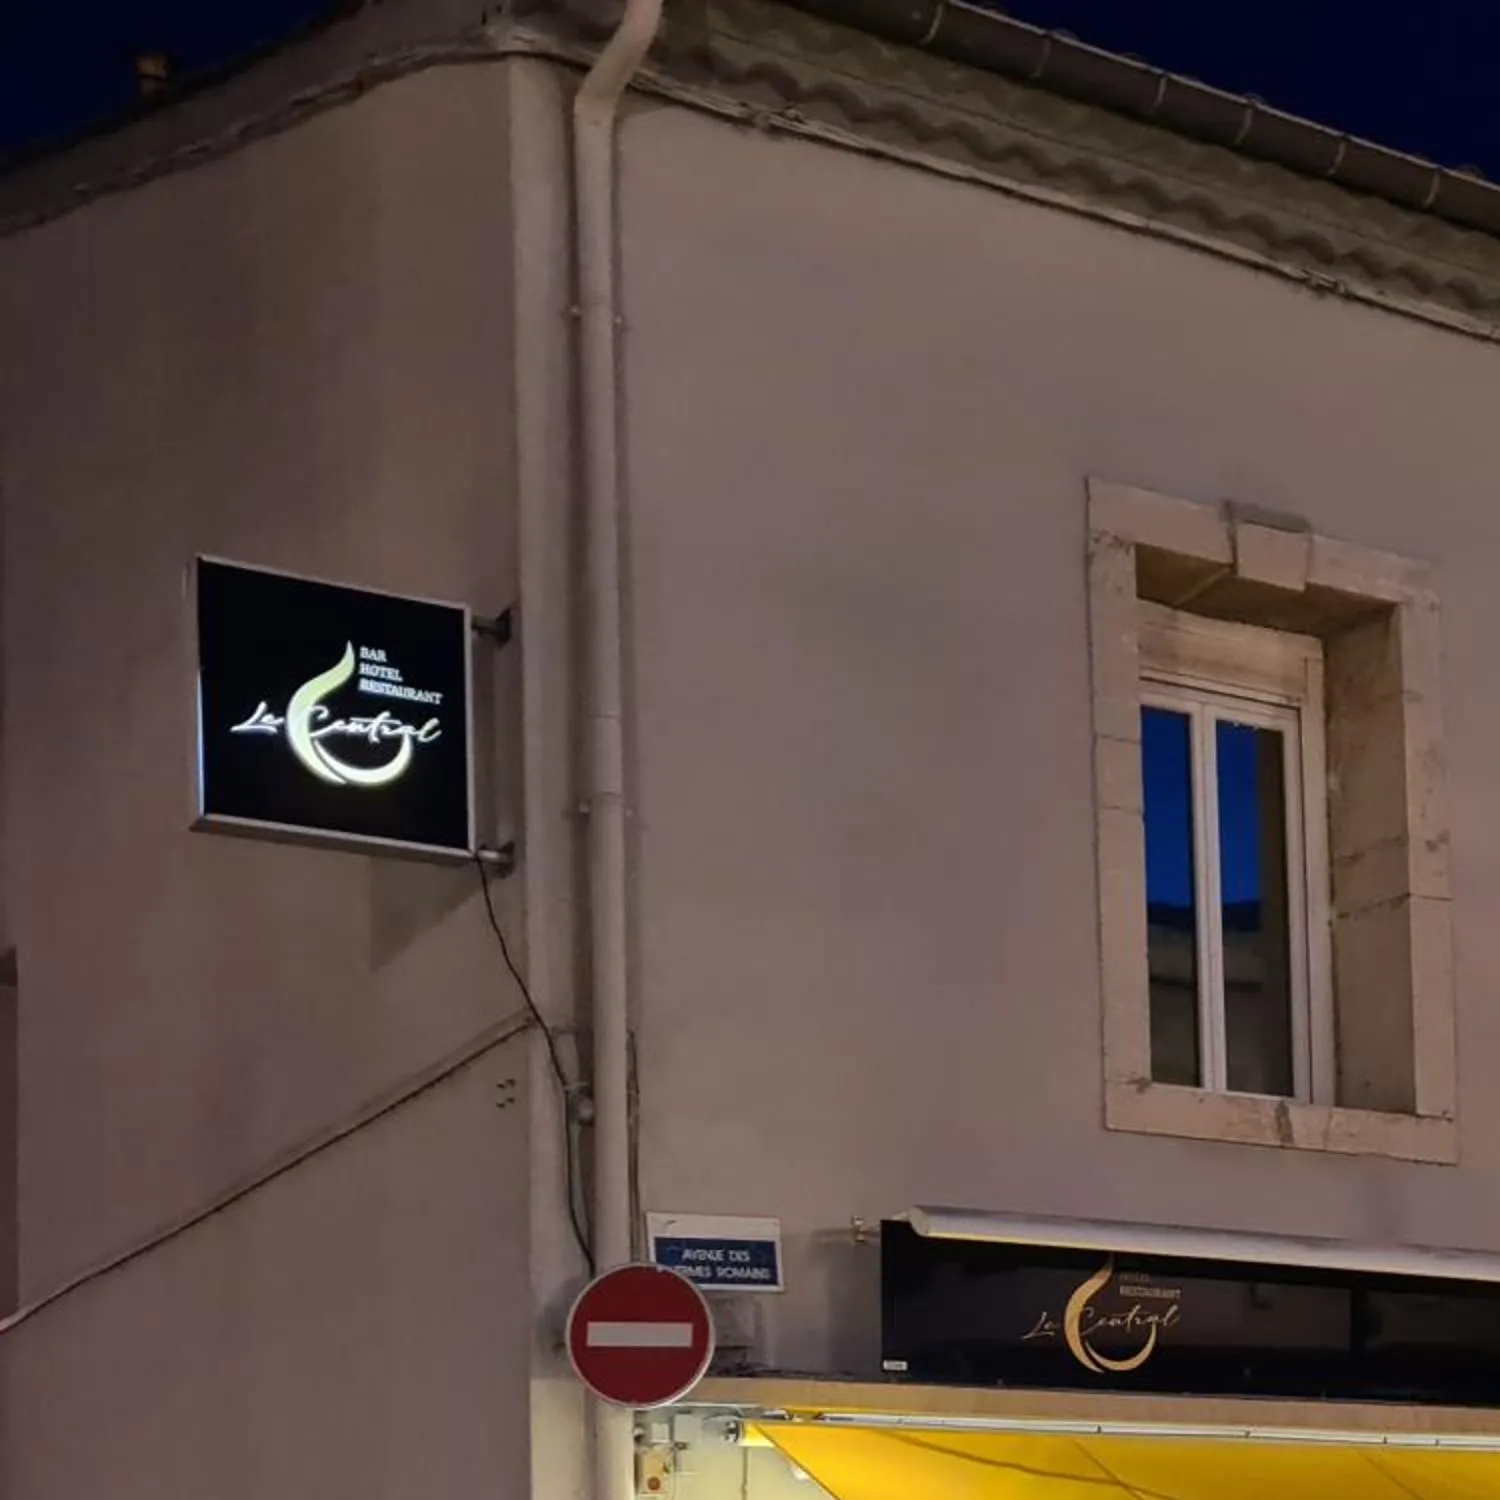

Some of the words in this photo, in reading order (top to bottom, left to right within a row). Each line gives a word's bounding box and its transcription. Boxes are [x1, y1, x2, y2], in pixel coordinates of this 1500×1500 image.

[360, 646, 387, 662] BAR
[359, 662, 403, 682] HOTEL
[359, 678, 442, 704] RESTAURANT
[230, 702, 284, 733] Le
[300, 705, 442, 743] Central
[1021, 1311, 1056, 1339] Le
